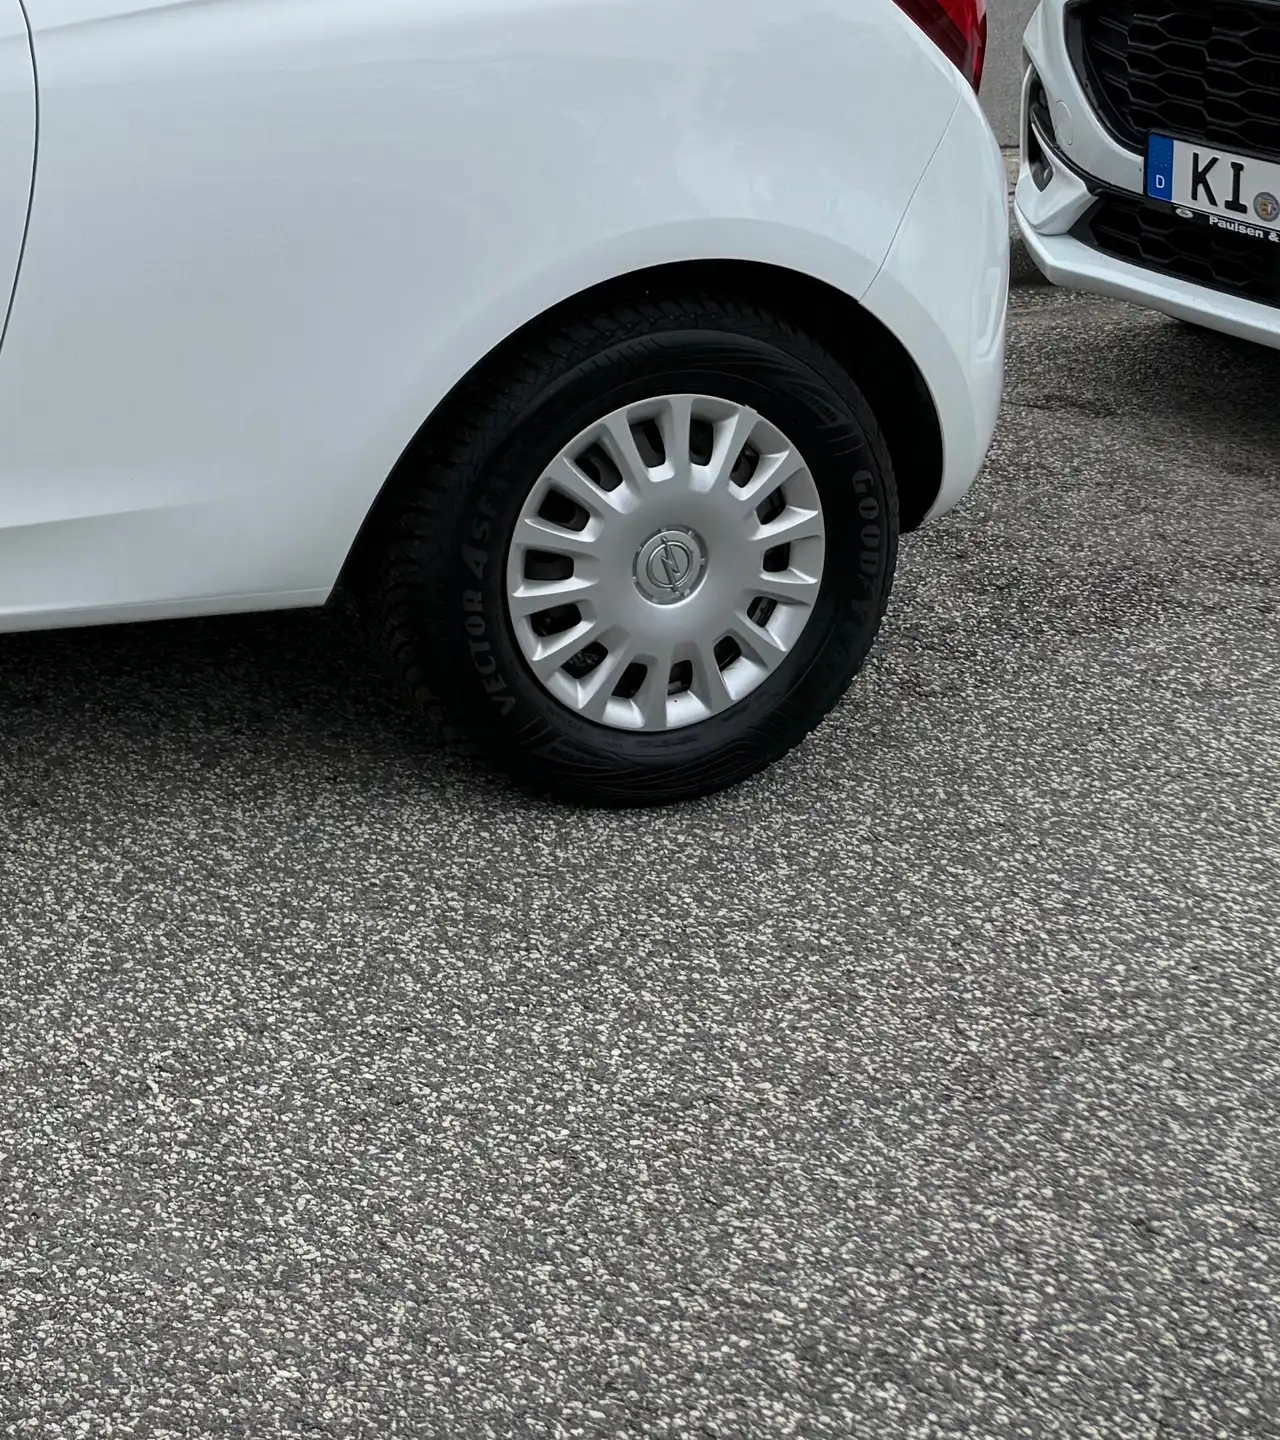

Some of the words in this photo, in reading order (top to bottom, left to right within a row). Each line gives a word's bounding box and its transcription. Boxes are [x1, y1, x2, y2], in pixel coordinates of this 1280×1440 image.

[1155, 173, 1166, 190] D
[1190, 152, 1248, 215] KI
[1209, 215, 1265, 239] Paulsen
[463, 587, 516, 717] VECTOR
